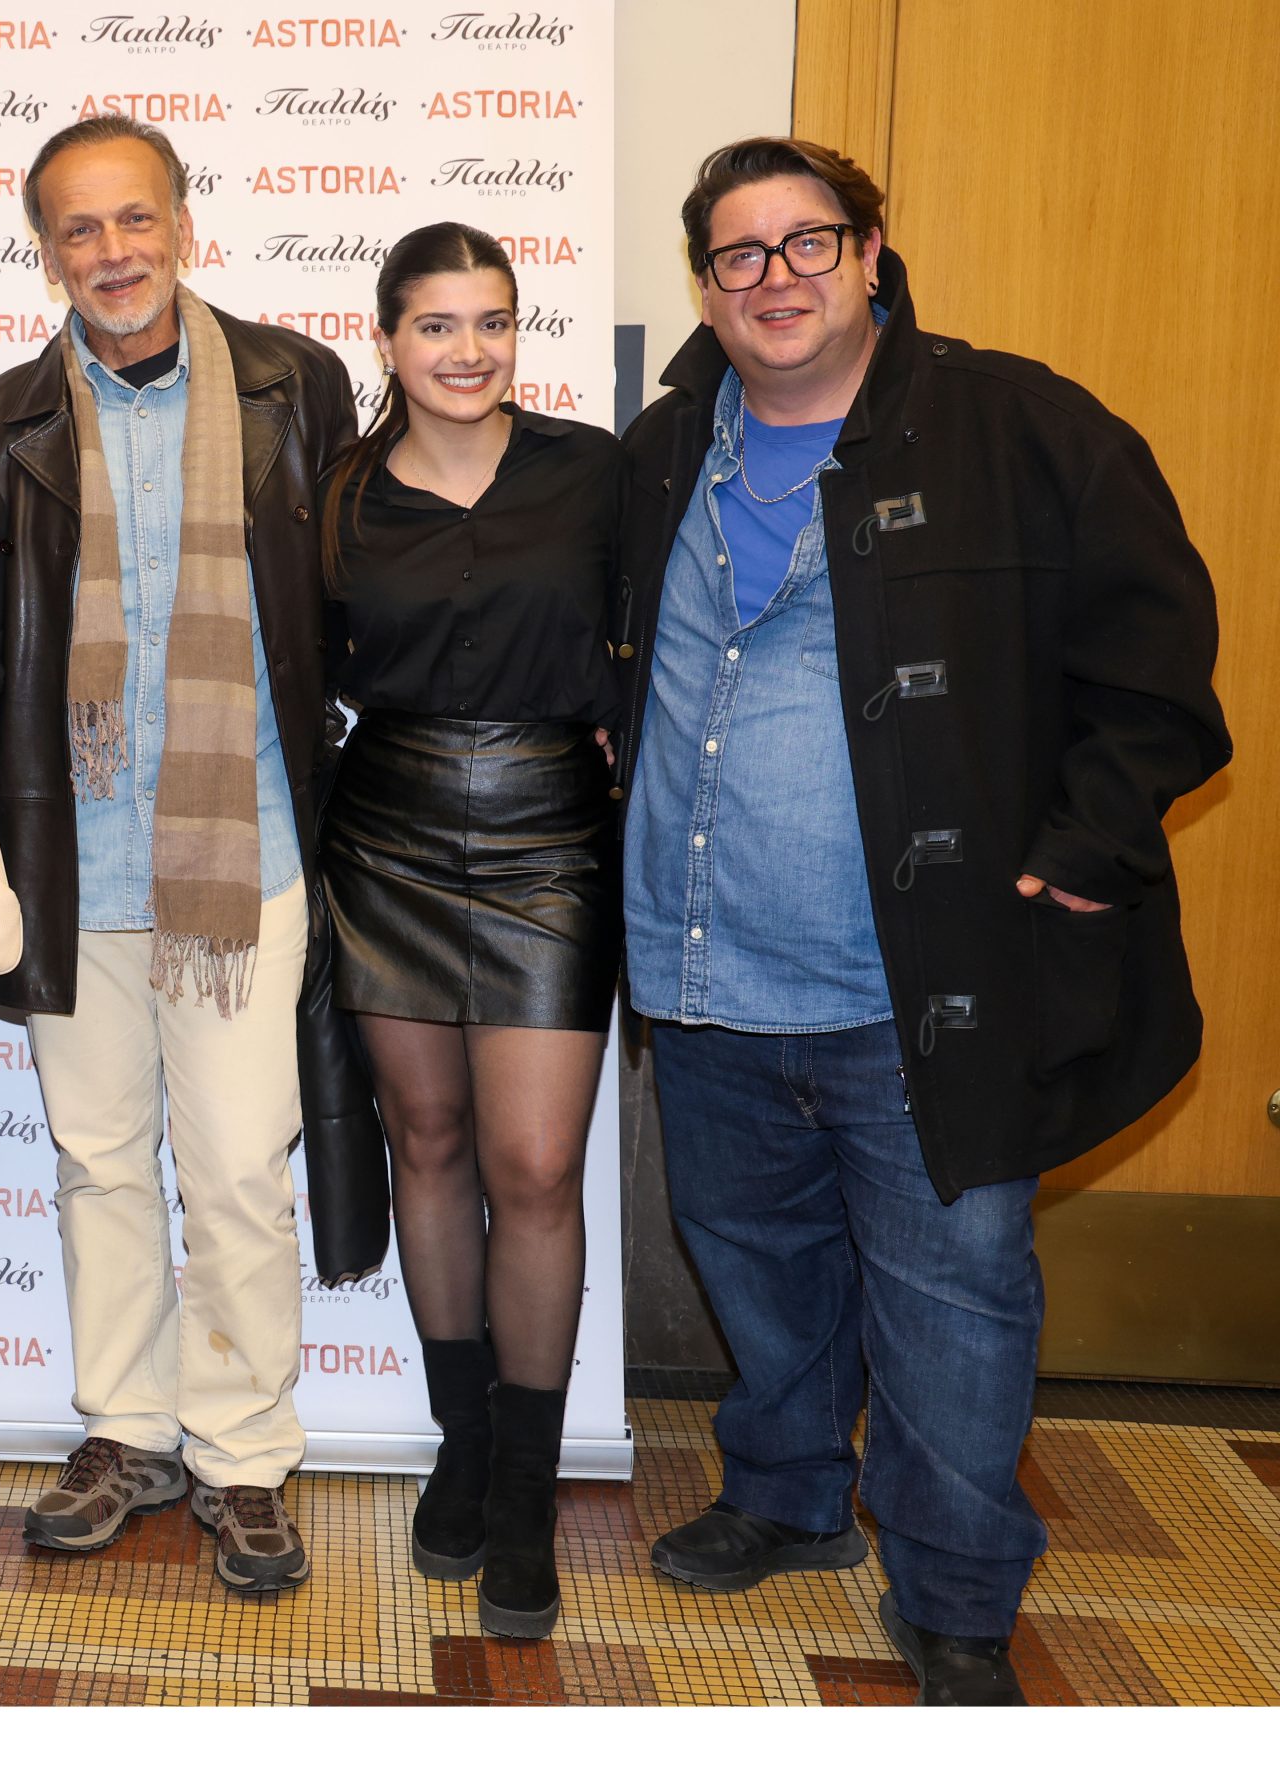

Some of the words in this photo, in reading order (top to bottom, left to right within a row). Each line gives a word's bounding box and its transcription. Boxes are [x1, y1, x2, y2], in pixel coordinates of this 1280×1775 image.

[252, 19, 401, 48] ASTORIA
[128, 46, 176, 54] ΘΕΑΤΡΟ
[478, 43, 527, 51] ΘΕΑΤΡΟ
[78, 94, 226, 122] ASTORIA
[427, 90, 576, 119] ASTORIA
[302, 118, 351, 126] ΘΕΑΤΡΟ
[252, 166, 400, 194] ASTORIA
[477, 189, 527, 197] ΘΕΑΤΡΟ
[302, 265, 351, 273] ΘΕΑΤΡΟ
[300, 1343, 403, 1376] TORIA
